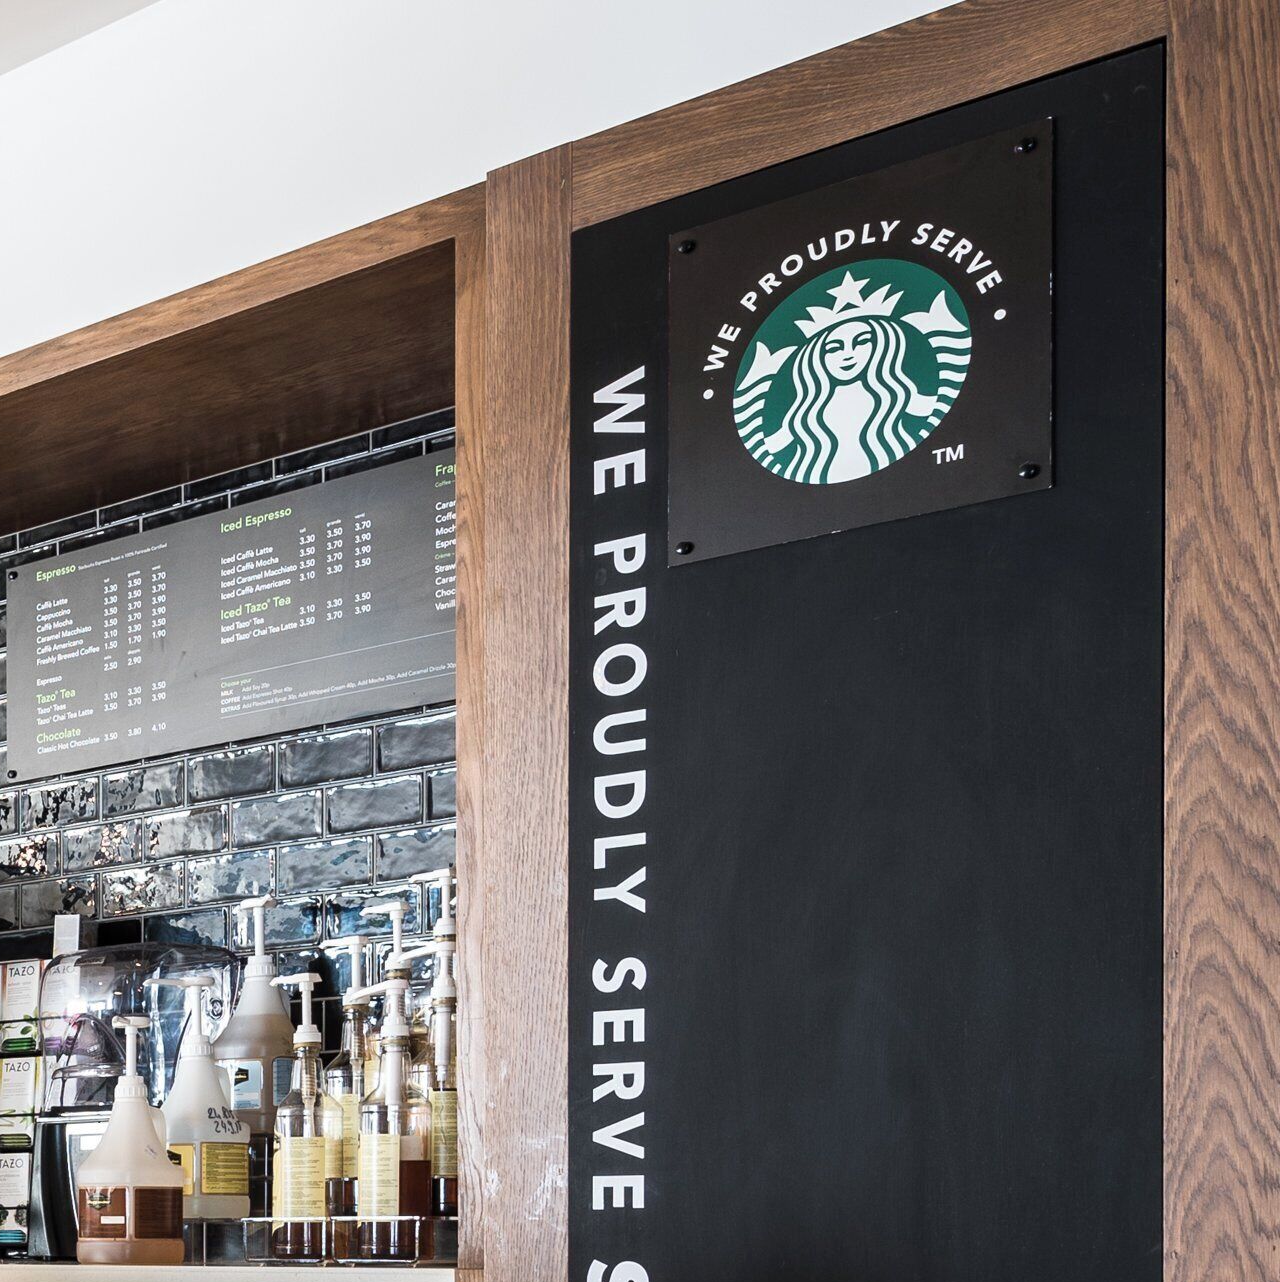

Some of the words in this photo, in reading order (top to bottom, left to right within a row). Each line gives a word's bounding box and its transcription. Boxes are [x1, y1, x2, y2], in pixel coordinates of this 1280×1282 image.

[703, 324, 742, 376] WE
[740, 220, 900, 313] PROUDLY
[911, 222, 1003, 294] SERVE
[593, 365, 645, 495] WE
[932, 444, 965, 465] TM
[220, 518, 242, 533] Iced
[245, 507, 292, 527] Espresso
[221, 554, 235, 564] Iced
[255, 546, 273, 556] Latte
[299, 534, 316, 545] 3.30
[326, 527, 343, 538] 3.50
[354, 520, 371, 531] 3.70
[221, 566, 235, 576] Iced
[255, 556, 279, 568] Mocha
[299, 547, 316, 557] 3.50
[326, 539, 343, 551] 3.70
[354, 532, 371, 544] 3.90
[36, 565, 76, 582] Espresso
[221, 578, 235, 588] Iced
[236, 572, 263, 585] Caramel
[264, 564, 297, 578] Macchiato
[299, 559, 316, 569] 3.50
[326, 552, 343, 563] 3.70
[354, 545, 371, 556] 3.90
[221, 590, 235, 600] Iced
[254, 578, 291, 592] Americano
[299, 571, 316, 582] 3.10
[326, 564, 343, 575] 3.30
[354, 557, 371, 568] 3.50
[36, 608, 71, 622] Cappuccino
[104, 595, 118, 605] 3.30
[127, 589, 141, 599] 3.50
[151, 583, 166, 593] 3.70
[53, 598, 68, 607] Latte
[104, 584, 118, 594] 3.30
[127, 578, 141, 588] 3.50
[151, 572, 166, 582] 3.70
[36, 632, 60, 644] Caramel
[62, 625, 92, 637] Macchiato
[104, 618, 118, 628] 3.50
[127, 612, 141, 622] 3.70
[151, 606, 166, 616] 3.90
[53, 619, 73, 629] Mocha
[104, 606, 118, 616] 3.50
[127, 600, 141, 611] 3.70
[151, 594, 166, 605] 3.90
[220, 605, 242, 620] Iced
[272, 596, 291, 607] Tea
[221, 623, 235, 633] Iced
[252, 617, 265, 626] Tea
[299, 604, 316, 615] 3.10
[326, 598, 343, 609] 3.30
[354, 591, 371, 602] 3.50
[221, 634, 235, 644] Iced
[252, 628, 267, 638] Chai
[268, 625, 280, 634] Tea
[280, 622, 298, 631] Latte
[299, 616, 316, 627] 3.50
[326, 610, 343, 621] 3.70
[354, 604, 371, 615] 3.90
[36, 654, 56, 666] Freshly
[58, 650, 79, 660] Brewed
[80, 646, 100, 656] Coffee
[104, 640, 118, 650] 1.50
[127, 635, 141, 645] 1.70
[151, 629, 166, 639] 1.90
[52, 639, 84, 651] Americano
[104, 629, 118, 639] 3.10
[127, 623, 141, 633] 3.30
[151, 618, 166, 628] 3.50
[36, 675, 62, 687] Espresso
[104, 661, 118, 671] 2.50
[127, 656, 141, 666] 2.90
[52, 713, 66, 722] Chai
[67, 710, 77, 719] Tea
[78, 708, 94, 717] Latte
[104, 702, 118, 712] 3.50
[127, 697, 141, 707] 3.70
[151, 692, 166, 702] 3.90
[60, 688, 76, 700] Tea
[104, 691, 118, 701] 3.10
[127, 686, 141, 696] 3.30
[151, 681, 166, 691] 3.50
[36, 728, 81, 744] Chocolate
[37, 744, 57, 754] Classic
[58, 742, 69, 751] Hot
[69, 737, 100, 748] Chocolate
[104, 732, 118, 742] 3.50
[151, 722, 166, 732] 4.10
[593, 533, 647, 914] PROUDLY
[8, 965, 35, 978] TAZO
[4, 1061, 31, 1073] TAZO
[592, 957, 647, 1211] SERVE
